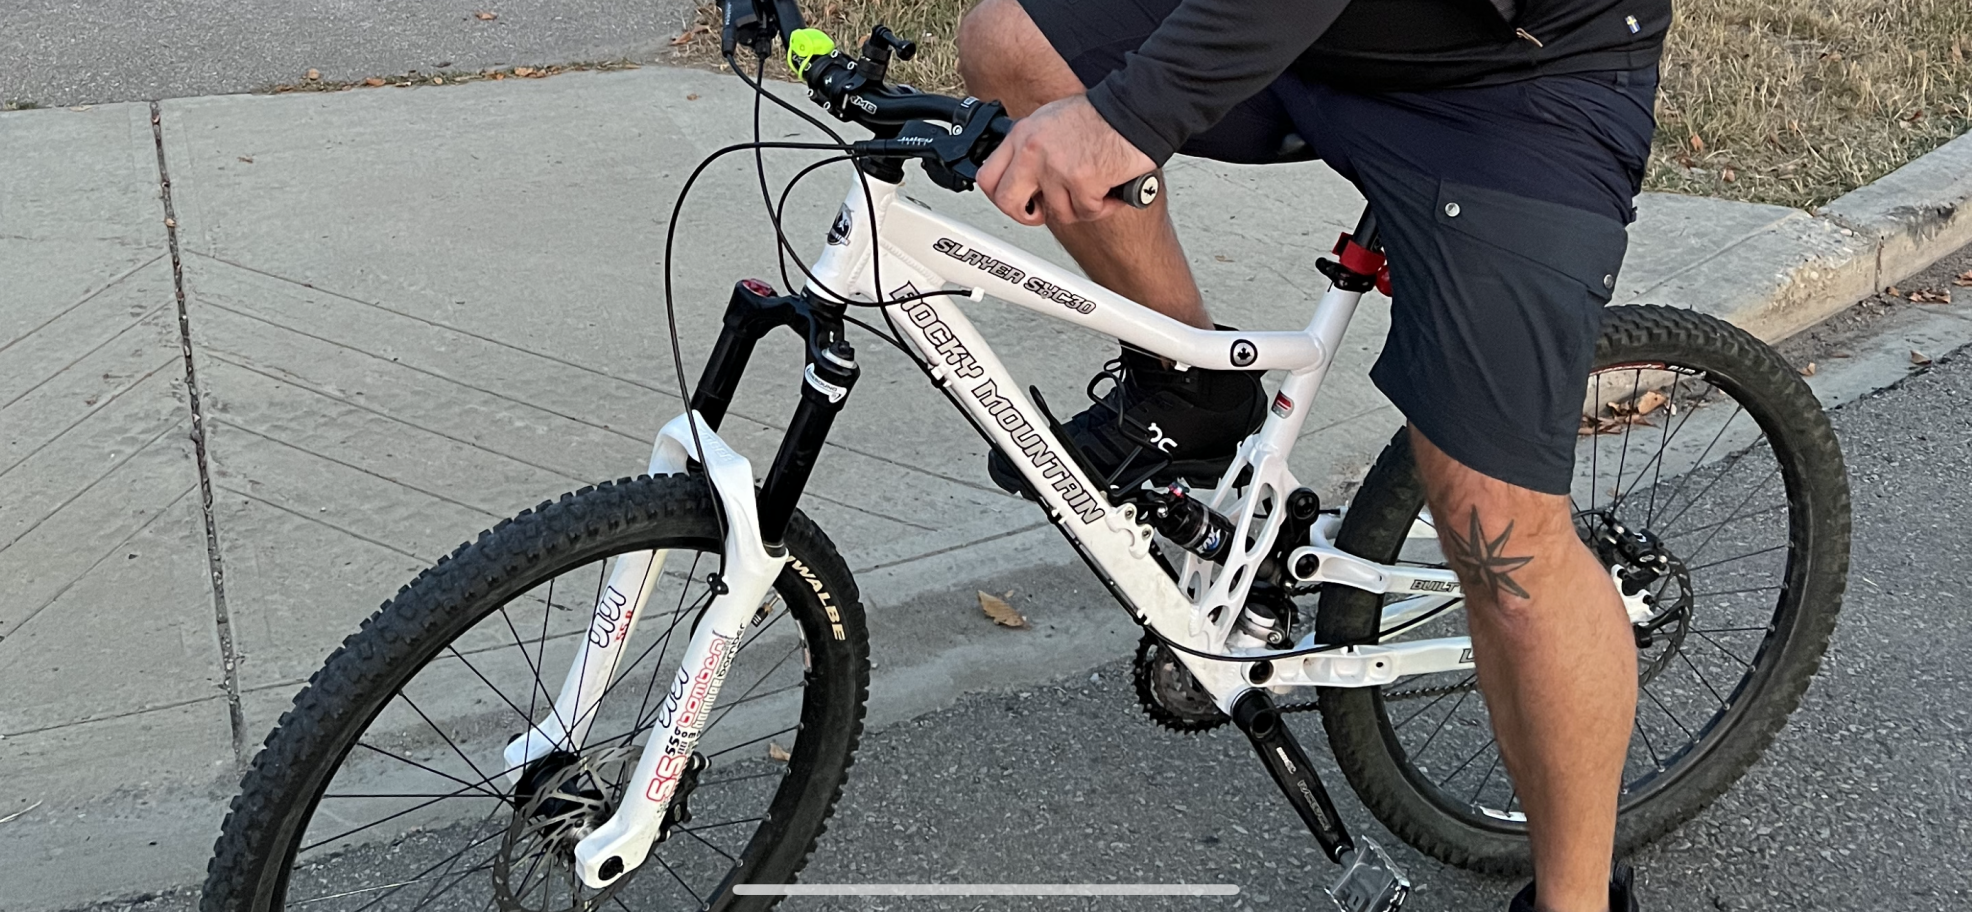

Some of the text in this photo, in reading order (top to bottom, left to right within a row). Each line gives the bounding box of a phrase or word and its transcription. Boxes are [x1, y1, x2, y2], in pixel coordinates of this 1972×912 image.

[933, 237, 1026, 284] SLAYER
[889, 280, 1106, 524] ROCKY MOUNTAIN
[1410, 579, 1460, 592] BUILT
